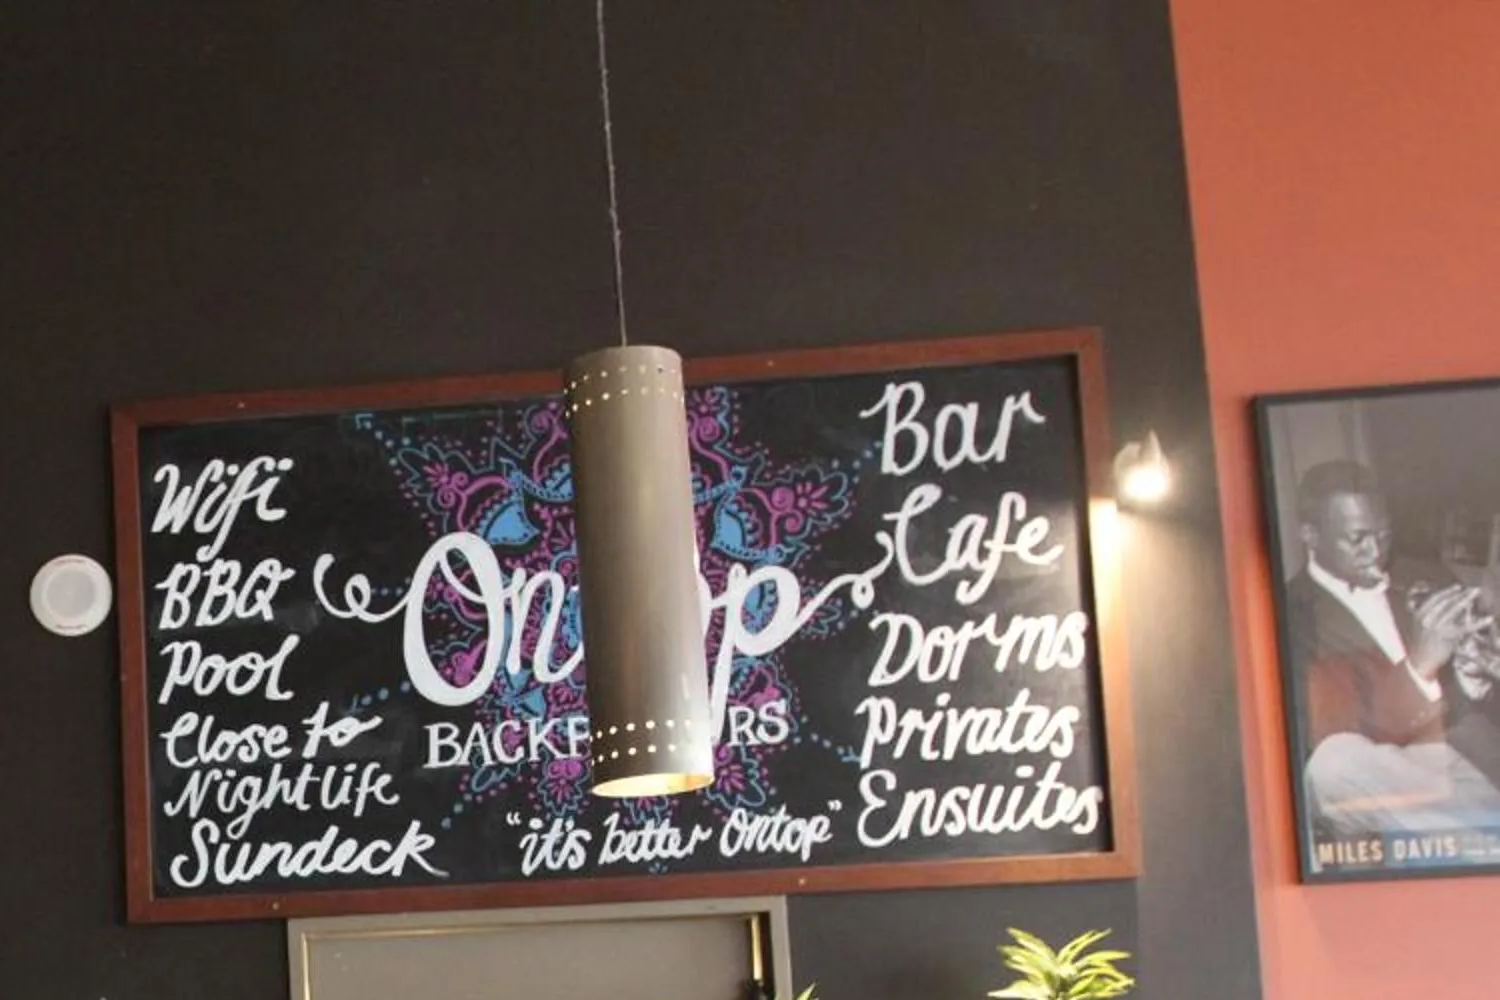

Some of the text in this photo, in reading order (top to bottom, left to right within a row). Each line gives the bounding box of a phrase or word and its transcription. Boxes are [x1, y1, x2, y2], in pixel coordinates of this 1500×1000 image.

[859, 380, 1045, 476] Bar
[151, 456, 293, 562] Wifi
[883, 483, 1063, 605] Cafe
[155, 557, 296, 630] BBQ
[159, 634, 300, 704] Pool
[403, 530, 802, 742] Onp
[869, 610, 1088, 687] Dorms
[160, 701, 383, 768] Close to
[855, 688, 1080, 768] Privates
[598, 811, 712, 865] better
[856, 761, 1103, 848] Ensuites
[170, 818, 448, 888] Sundeck
[1318, 839, 1383, 865] MILES
[1394, 836, 1457, 861] DAVIS
